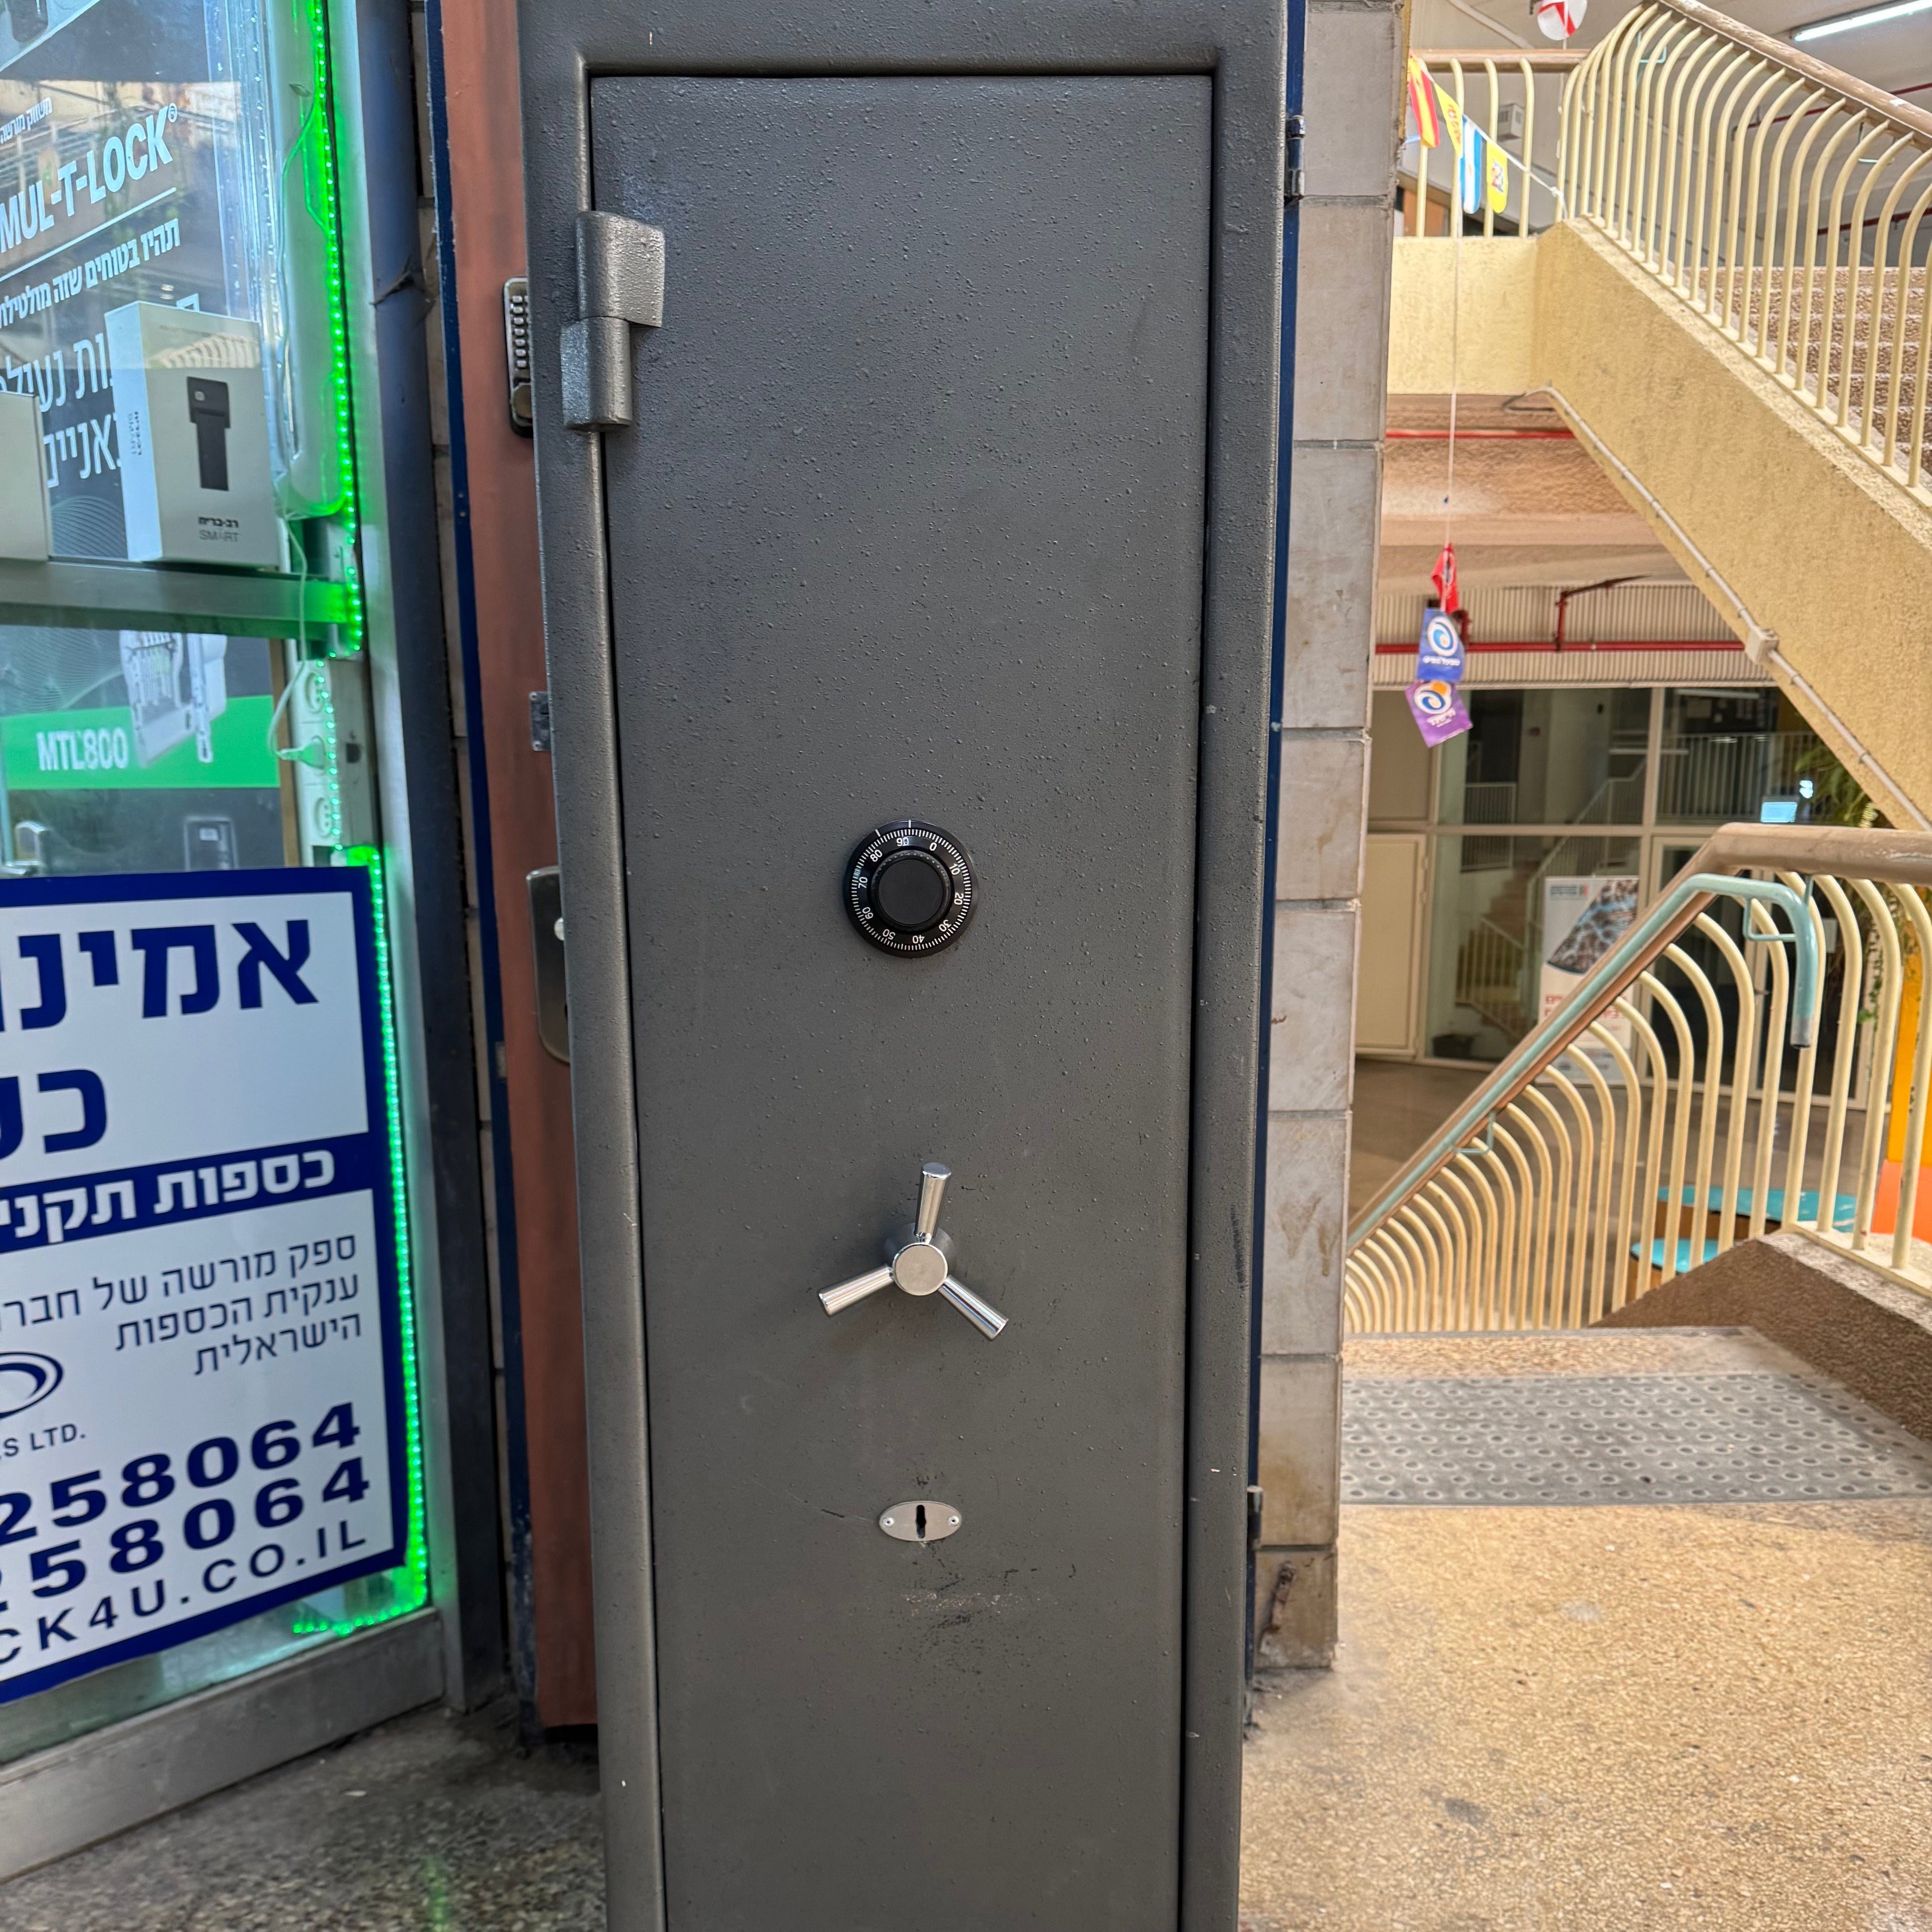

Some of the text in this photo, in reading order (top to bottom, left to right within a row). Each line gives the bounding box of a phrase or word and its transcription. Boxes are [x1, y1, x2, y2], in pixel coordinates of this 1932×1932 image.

[84, 238, 140, 288] בטוחים
[53, 266, 83, 303] שזה
[0, 283, 52, 329] מולטילו
[36, 728, 129, 771] MTL800
[870, 849, 883, 862] 80
[896, 836, 909, 846] 90
[929, 842, 937, 852] 0
[858, 877, 868, 889] 70
[949, 863, 960, 875] 10
[862, 907, 874, 920] 60
[954, 892, 964, 905] 20
[882, 928, 896, 941] 50
[912, 934, 925, 944] 40
[939, 919, 952, 932] 30
[0, 920, 319, 1032] אמינ
[154, 1150, 336, 1215] כספות
[0, 1234, 356, 1332] ספק מורשה של חבר
[115, 1274, 359, 1351] ענקית הכספות
[194, 1313, 361, 1376] הישראלית
[0, 1423, 86, 1460] S LTD.
[0, 1457, 370, 1612] 58064
